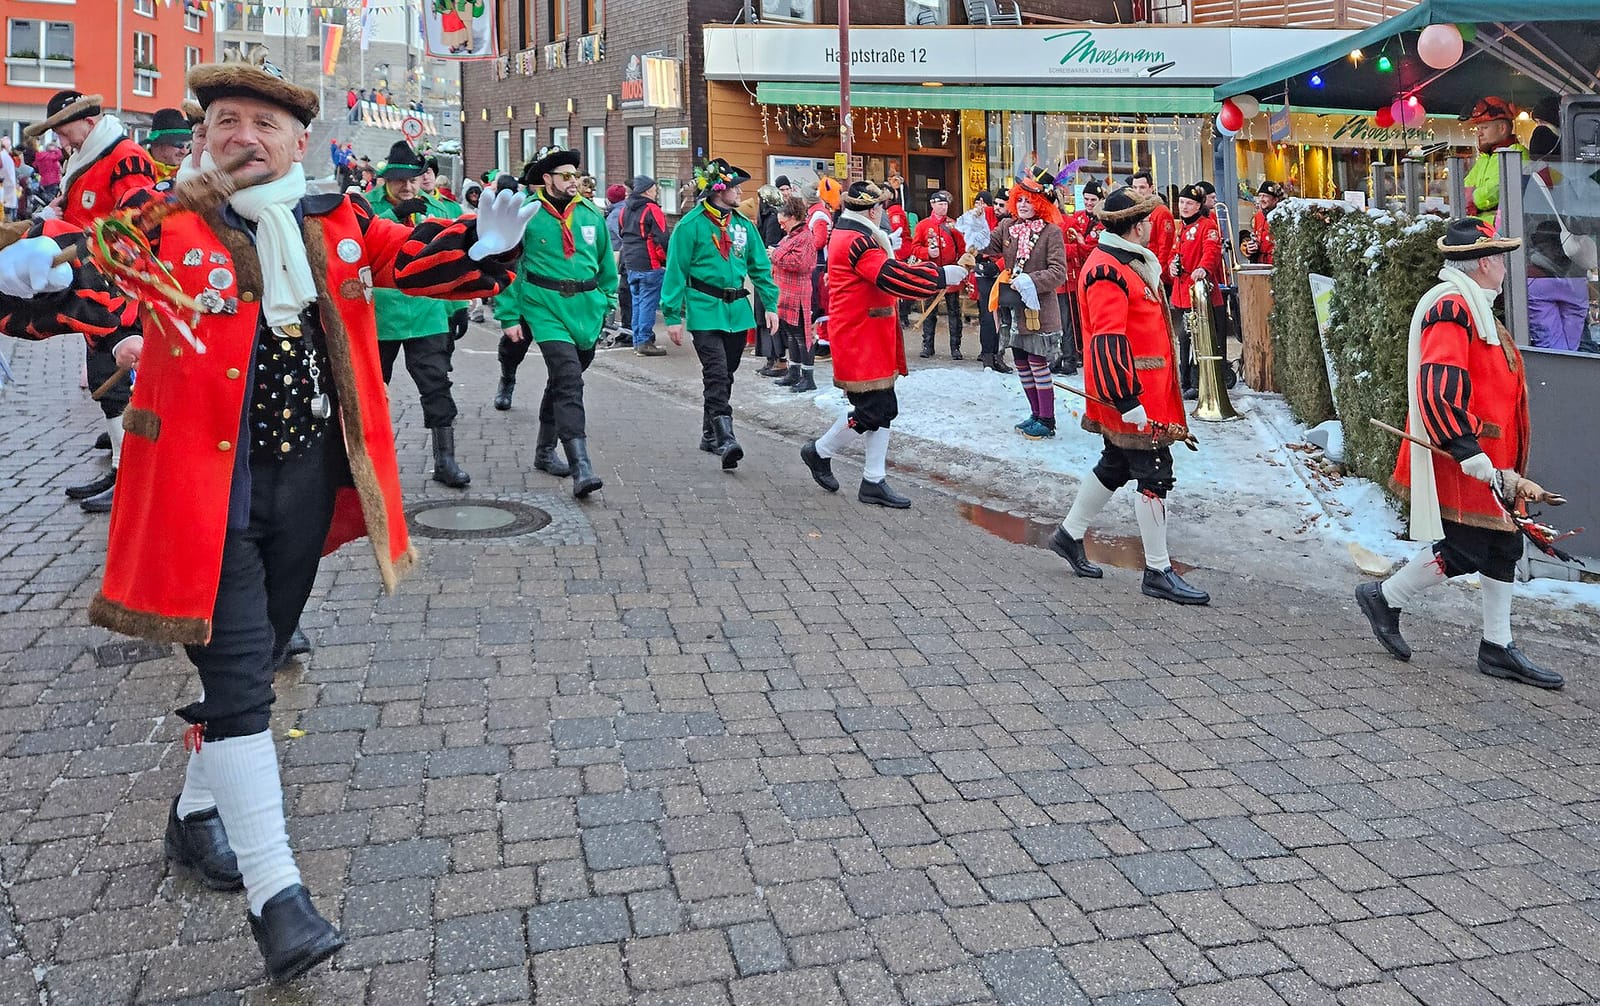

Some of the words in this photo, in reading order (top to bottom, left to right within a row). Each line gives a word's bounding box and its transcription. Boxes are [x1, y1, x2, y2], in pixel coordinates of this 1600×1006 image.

[825, 48, 905, 65] Haptstraße
[910, 48, 927, 63] 12
[1043, 30, 1165, 65] Moosmann
